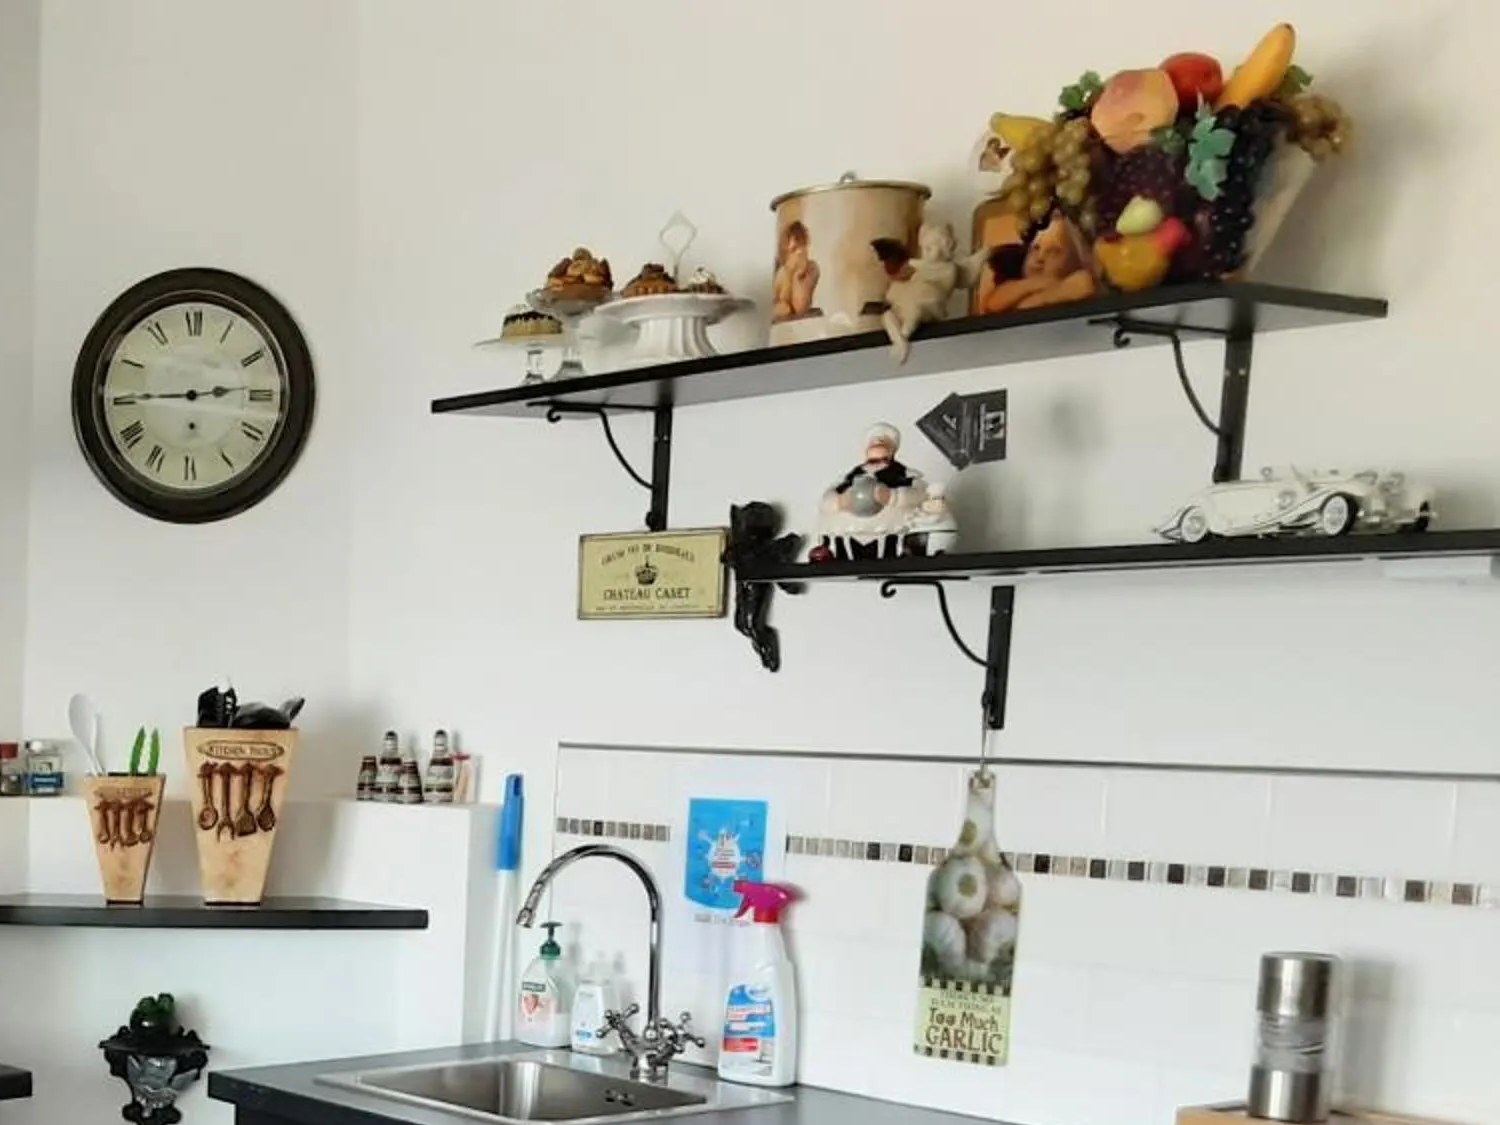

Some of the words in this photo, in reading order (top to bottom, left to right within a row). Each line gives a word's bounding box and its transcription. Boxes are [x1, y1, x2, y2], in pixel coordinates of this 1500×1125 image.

[928, 1006, 957, 1026] Too
[960, 1010, 999, 1032] Much
[924, 1025, 1004, 1055] GARLIC
